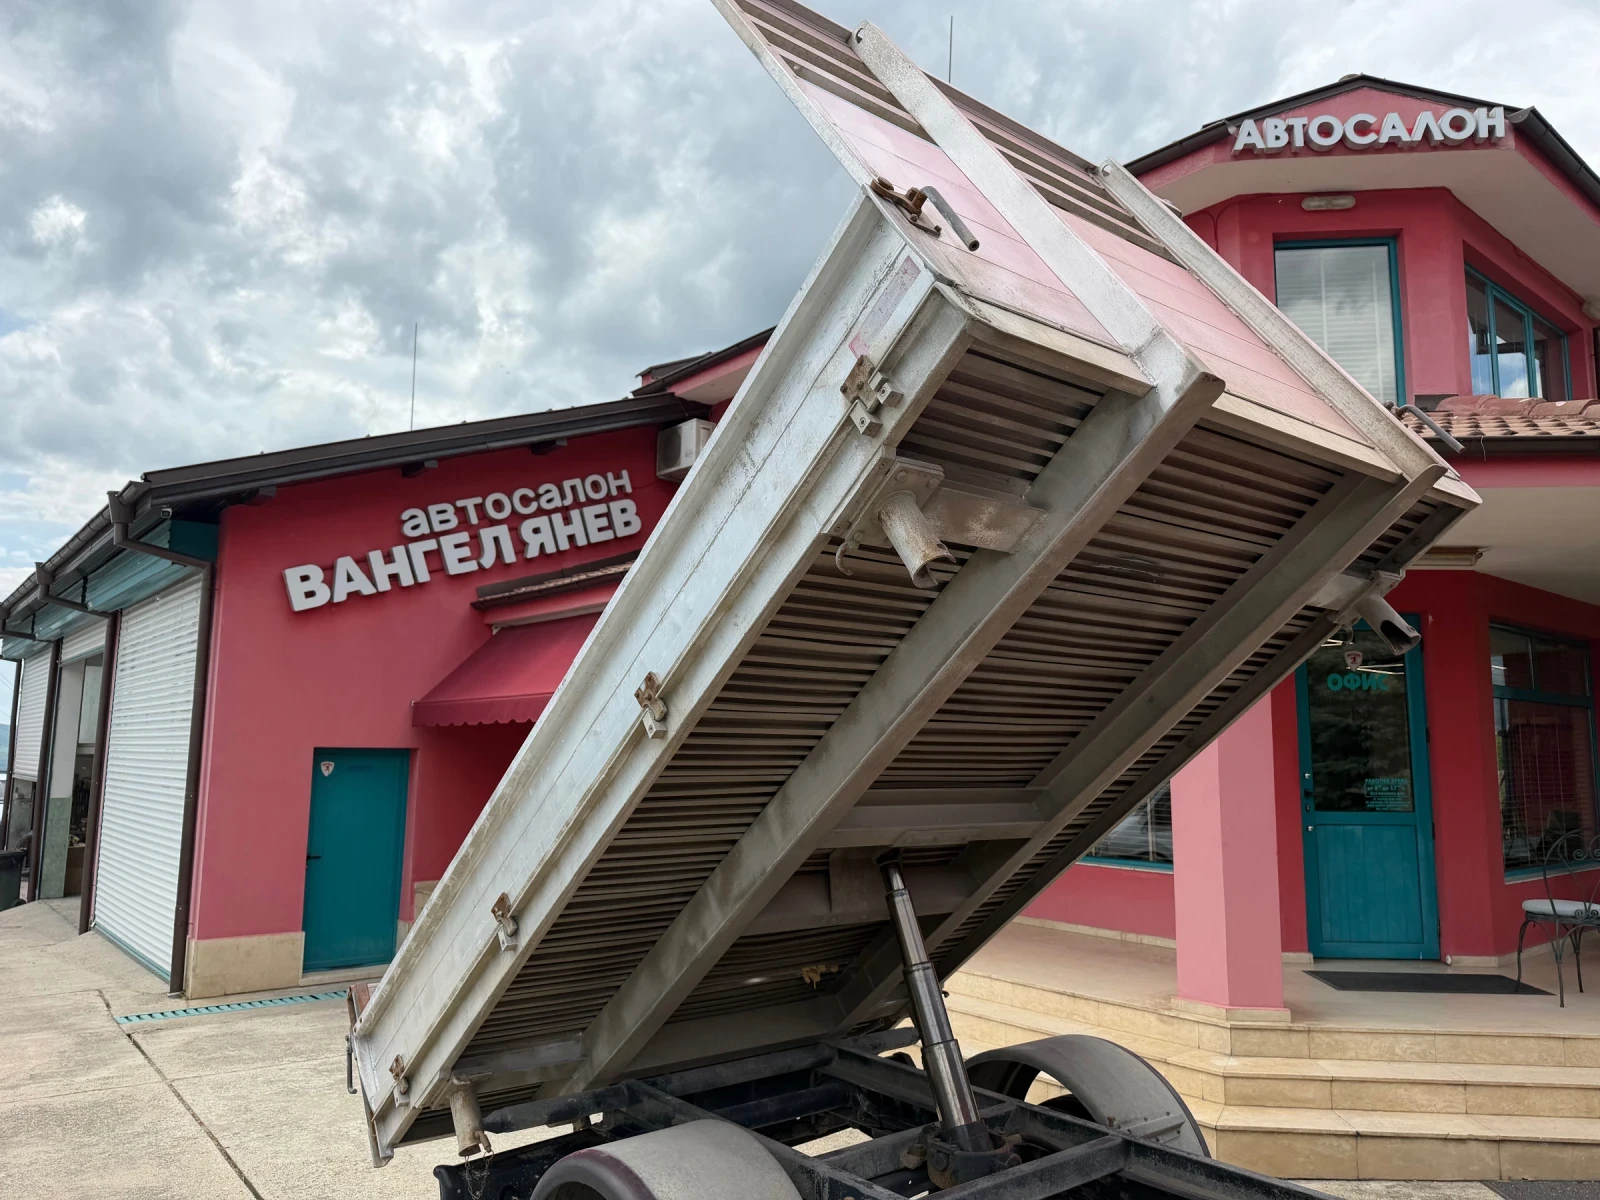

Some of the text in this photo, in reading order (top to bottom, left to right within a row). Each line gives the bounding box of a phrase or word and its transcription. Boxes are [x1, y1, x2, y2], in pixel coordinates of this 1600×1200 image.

[1231, 106, 1505, 153] АВТОСАЛОН
[400, 469, 633, 538] автосалон
[282, 499, 642, 612] ВАНГЕЛ ЯНЕВ
[1326, 673, 1390, 691] ОФИС
